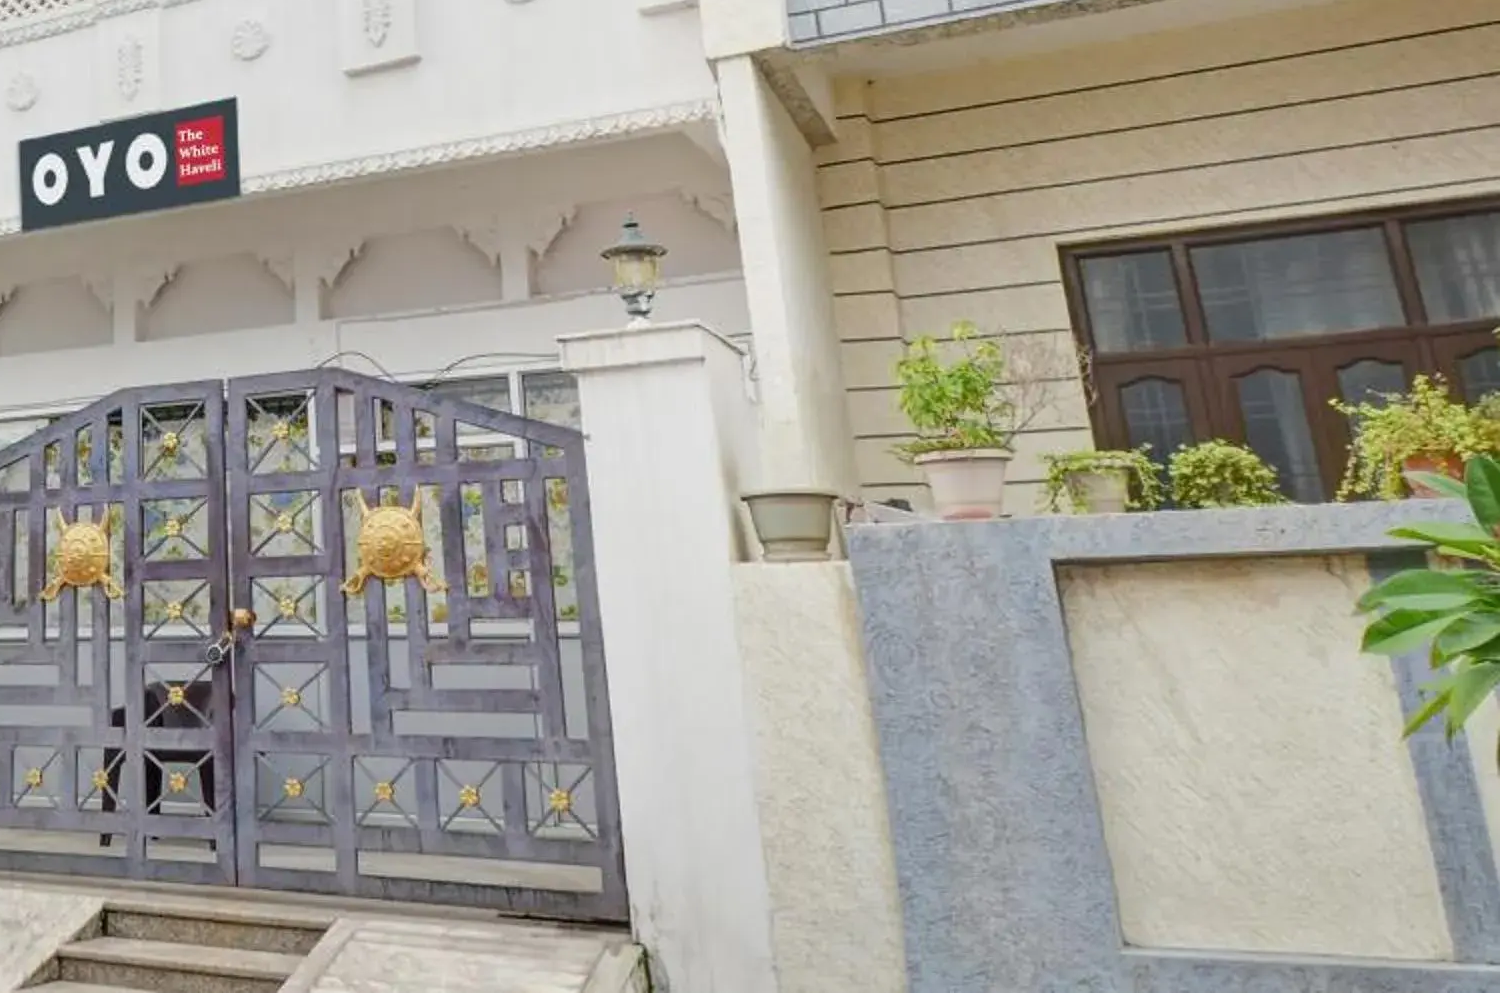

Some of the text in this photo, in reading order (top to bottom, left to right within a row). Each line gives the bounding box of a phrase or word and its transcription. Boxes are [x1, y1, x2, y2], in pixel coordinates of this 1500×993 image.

[179, 129, 203, 142] The
[180, 144, 219, 158] White
[32, 133, 168, 205] OYO
[180, 159, 222, 177] Haveli
